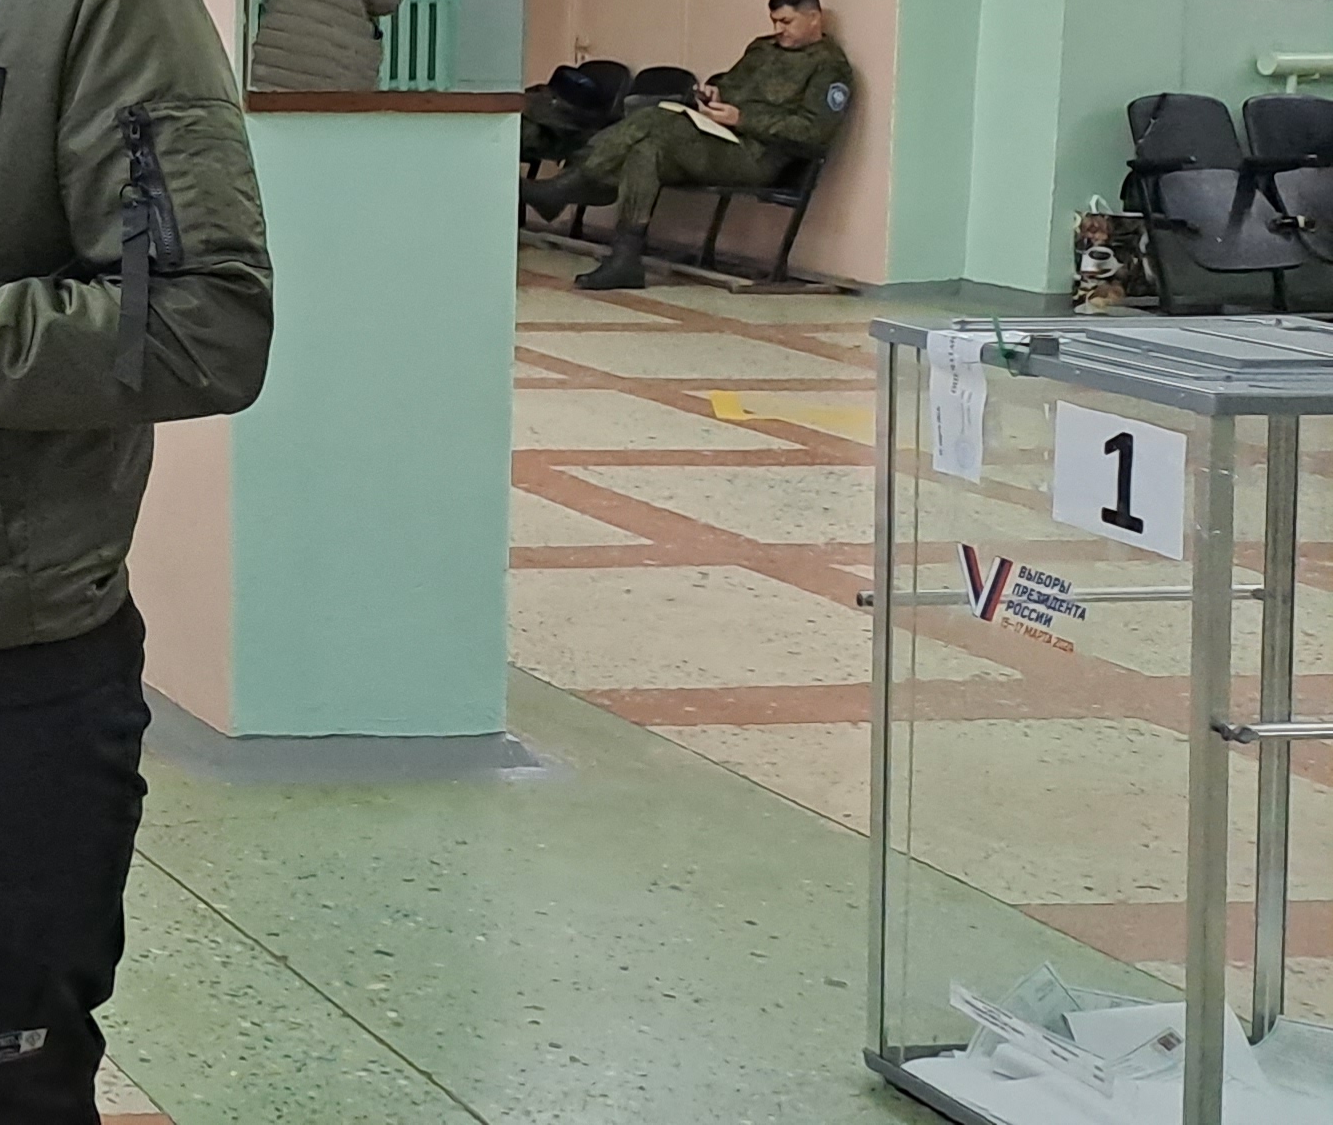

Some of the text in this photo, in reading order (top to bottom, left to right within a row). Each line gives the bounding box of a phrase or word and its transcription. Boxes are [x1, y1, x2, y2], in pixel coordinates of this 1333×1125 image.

[1101, 432, 1144, 535] 1
[1018, 565, 1072, 595] ВЫБОРЫ
[1005, 600, 1053, 628] РОССИИ
[1012, 583, 1086, 621] ПРЕЗИДЕНТА
